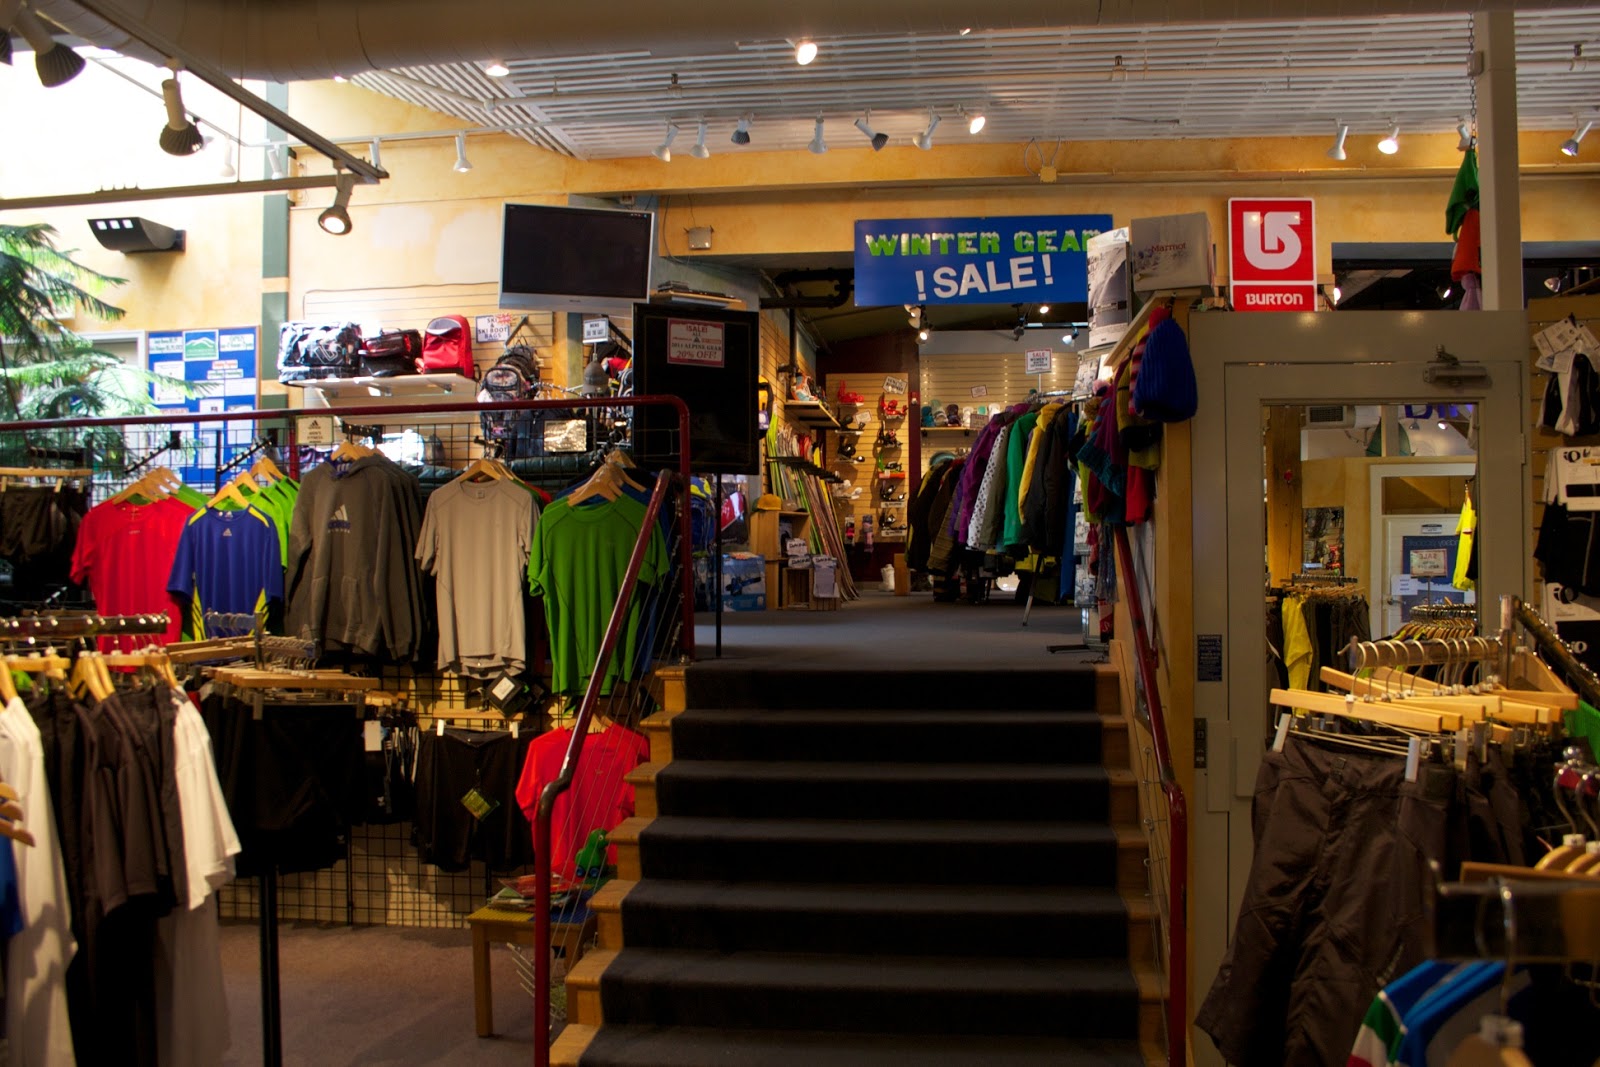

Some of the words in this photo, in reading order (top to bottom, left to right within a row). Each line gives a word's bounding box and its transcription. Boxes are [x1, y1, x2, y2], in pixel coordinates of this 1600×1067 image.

[865, 231, 1000, 256] WINTER
[1151, 242, 1186, 253] Marmot
[1245, 293, 1304, 305] BURTON
[696, 351, 717, 359] OFF!
